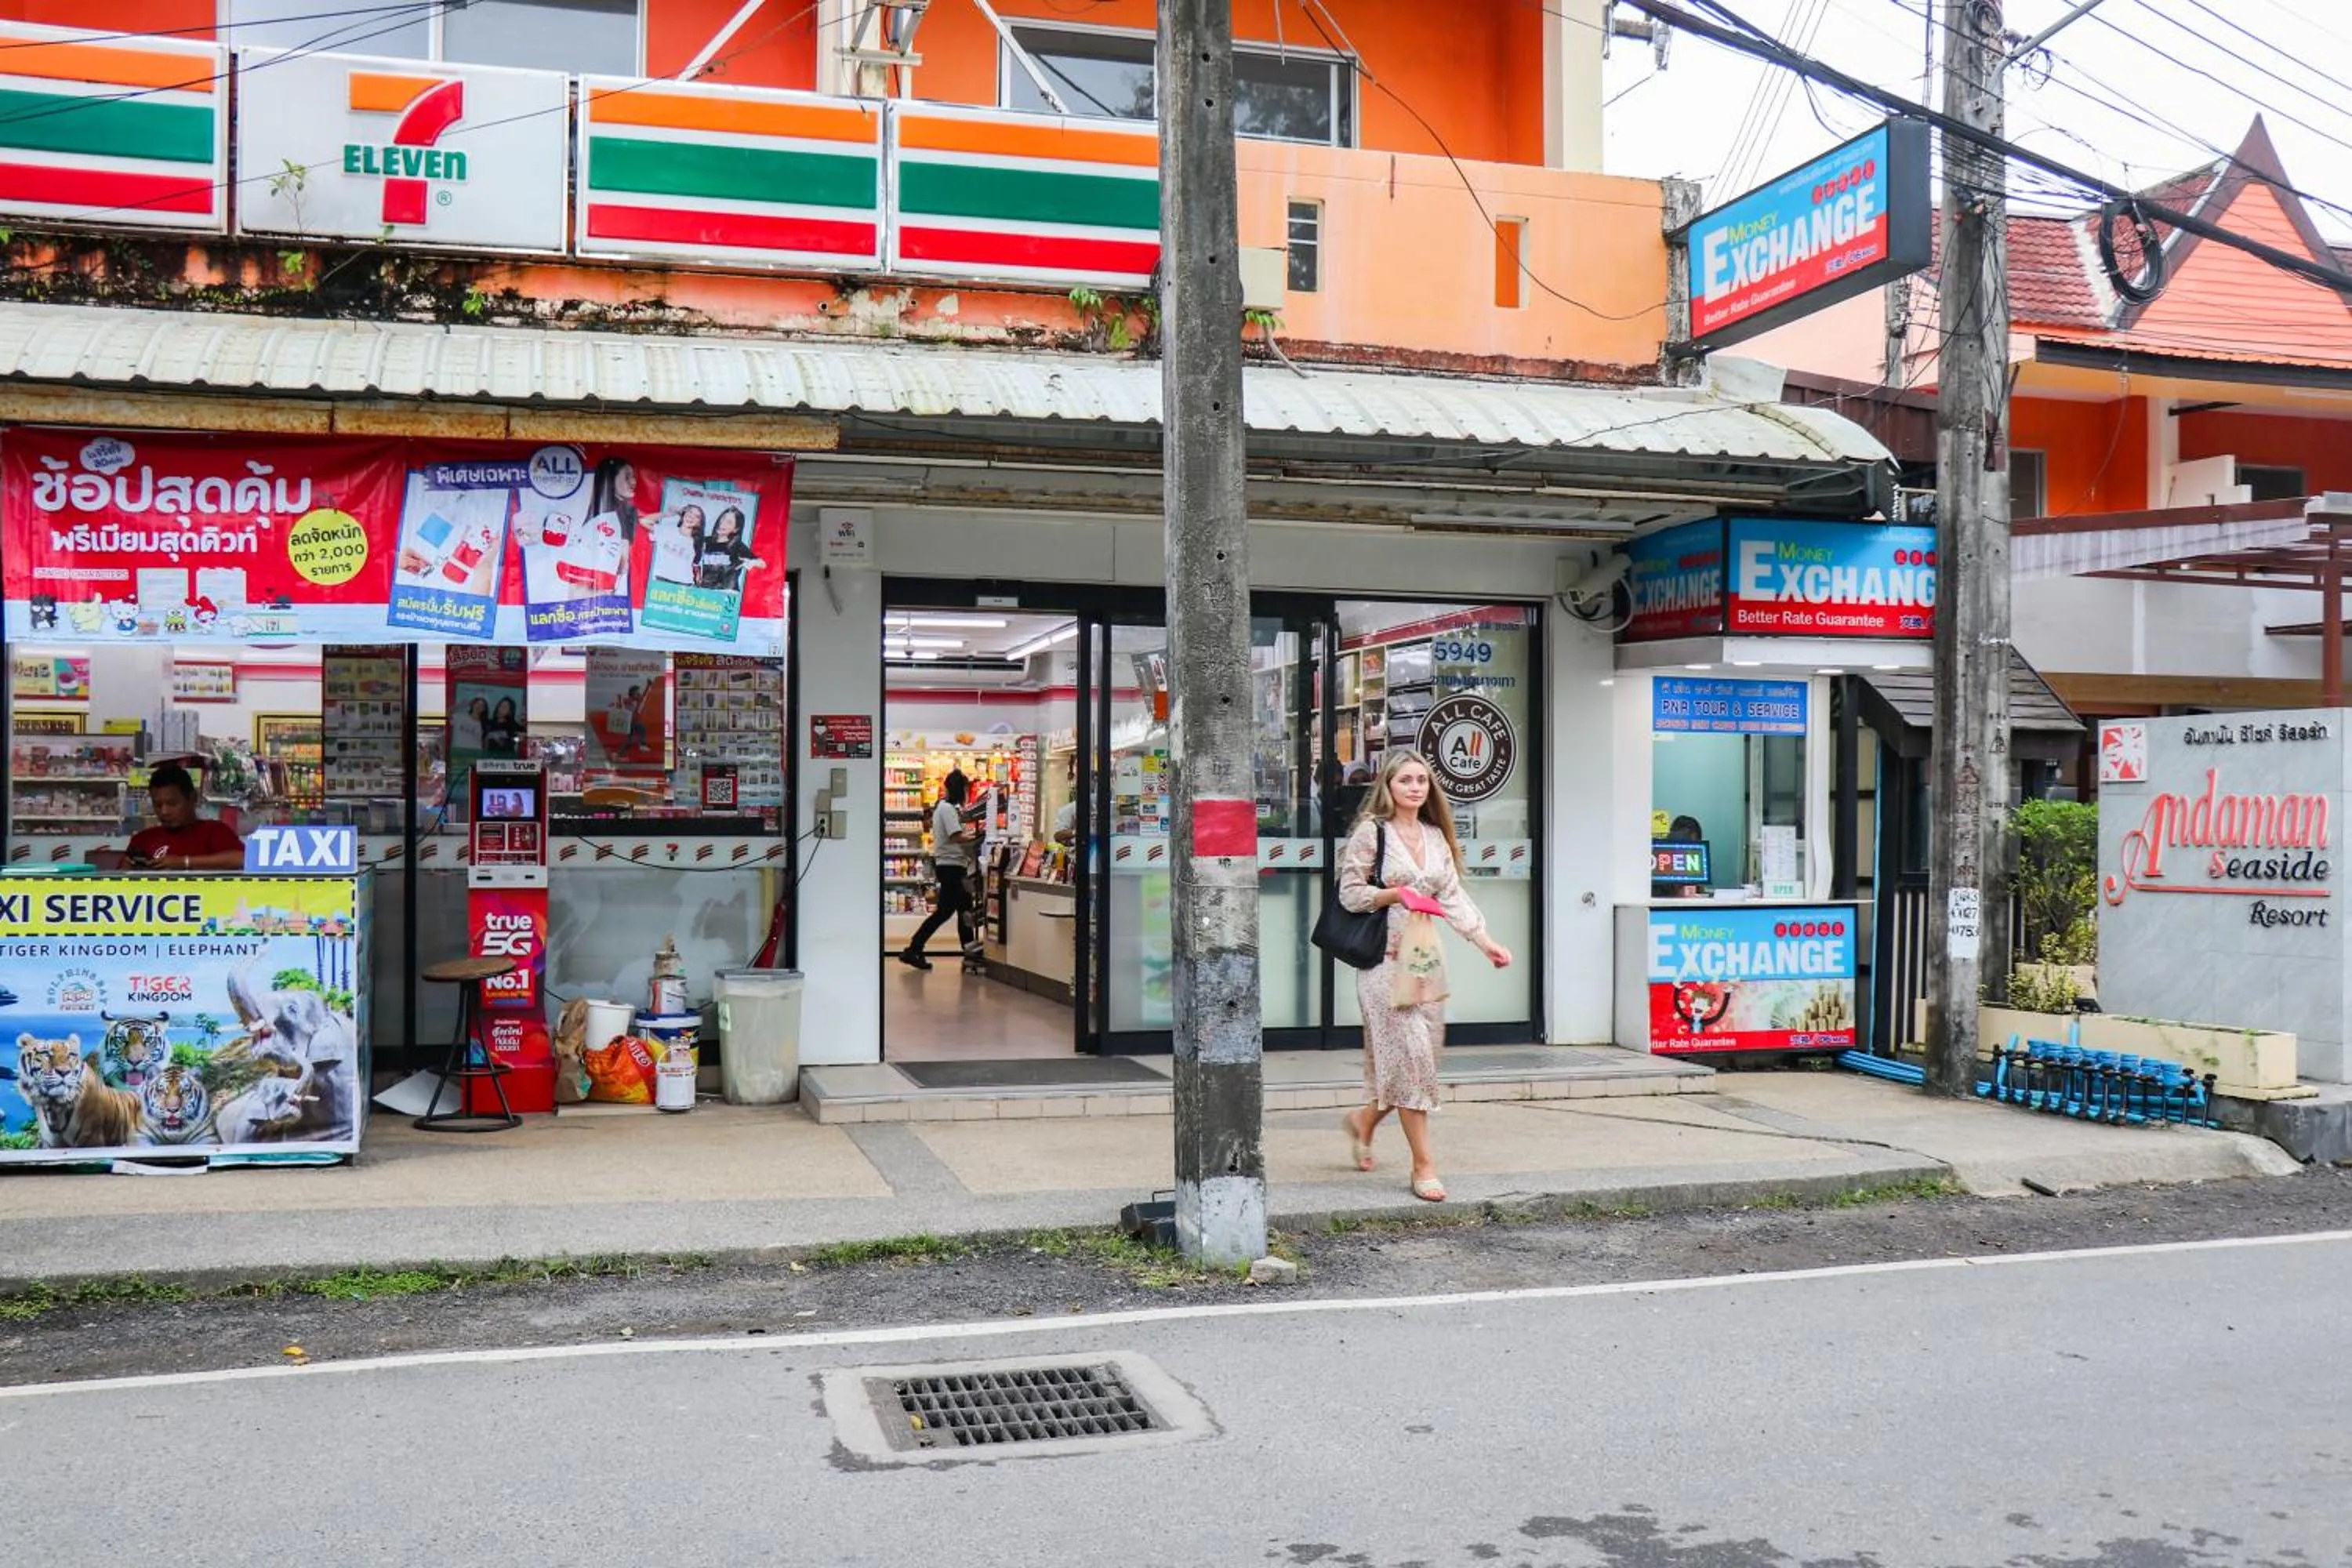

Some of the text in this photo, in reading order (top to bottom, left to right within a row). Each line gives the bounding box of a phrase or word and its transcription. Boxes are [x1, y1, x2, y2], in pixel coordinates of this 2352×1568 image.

[1703, 183, 1877, 305] EXCHANGE
[436, 466, 527, 484] พิเศษเฉพาะ
[533, 456, 579, 474] ALL
[32, 456, 311, 528] ช้อปสุดคุ้ม
[50, 523, 257, 563] พรีเมียมสุดคิวท์
[291, 524, 361, 546] ลดจัดหนัก
[294, 543, 365, 562] กว่า 2,000
[1778, 543, 1833, 563] MONEY
[311, 562, 352, 576] รายการ
[1739, 539, 1936, 608] EXCHANG
[530, 604, 575, 625] แลกซื้อ
[1737, 609, 1778, 624] Better
[1783, 611, 1813, 625] Rate
[1816, 612, 1883, 627] Guarantee
[1434, 641, 1493, 662] 5949
[1693, 700, 1728, 716] TOUR
[1748, 702, 1799, 718] SERVICE
[1429, 704, 1465, 736] ALL
[2183, 727, 2234, 746] อันดามัน
[514, 761, 536, 770] true
[1450, 757, 1481, 769] Cafe
[1455, 782, 1487, 794] GREAT
[1487, 757, 1507, 786] TASTE
[2103, 768, 2329, 906] Andaman
[250, 829, 351, 867] TAXI
[2208, 850, 2331, 882] Seaside
[45, 894, 201, 924] SERVICE
[2249, 899, 2329, 928] Resort
[485, 912, 532, 931] true
[1682, 924, 1734, 941] MONEY
[59, 944, 147, 956] KINGDOM
[169, 944, 259, 956] ELEPHANT
[481, 931, 534, 956] 5G
[1649, 923, 1844, 978] EXCHANGE
[128, 976, 191, 991] TIGER
[128, 992, 192, 1002] KINGDOM
